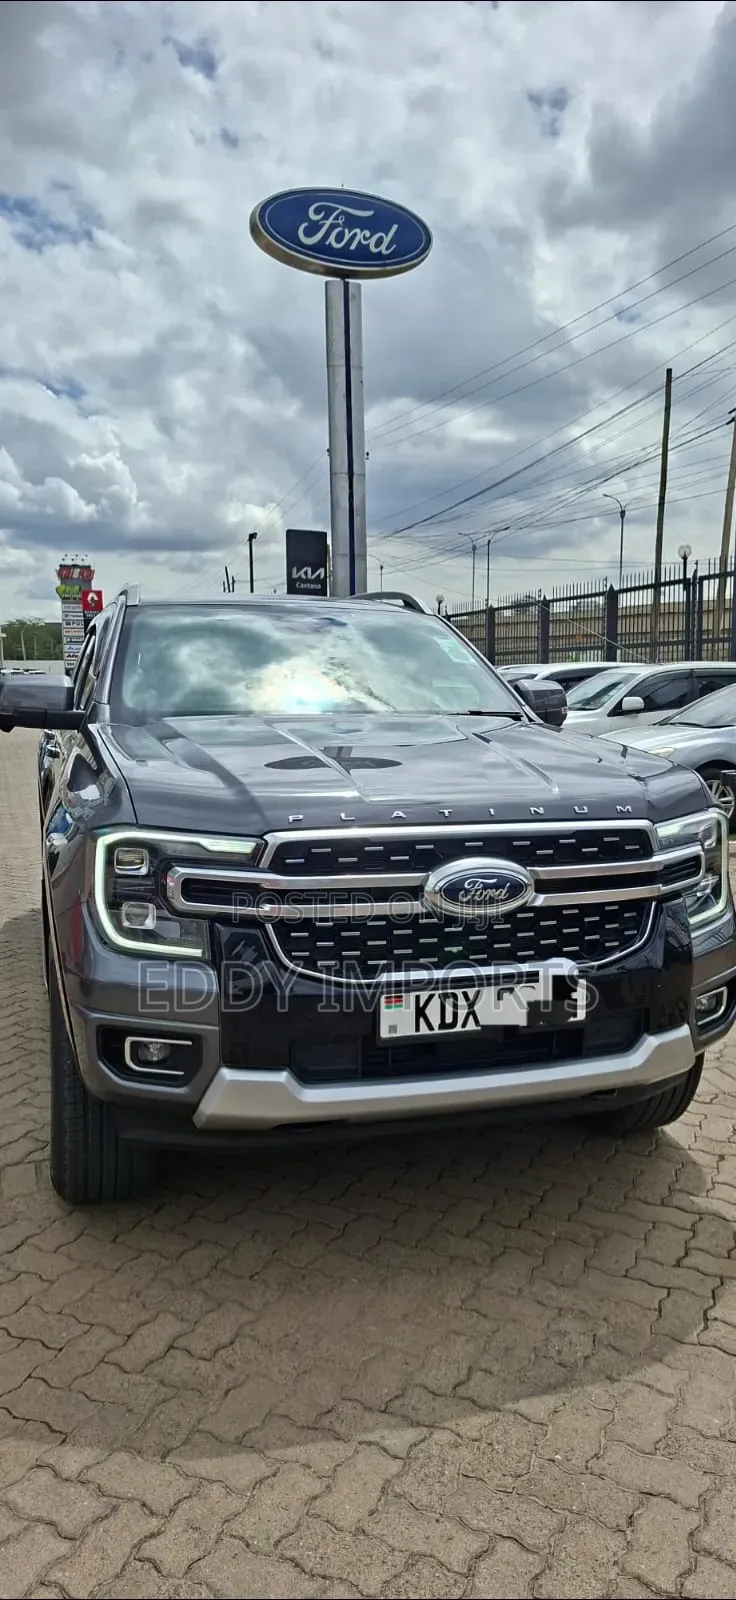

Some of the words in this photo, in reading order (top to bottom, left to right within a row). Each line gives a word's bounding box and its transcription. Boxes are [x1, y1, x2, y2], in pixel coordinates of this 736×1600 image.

[298, 202, 399, 254] Ford
[292, 566, 325, 579] KIA
[287, 805, 633, 824] PLATINUM
[459, 877, 510, 902] Ford
[414, 989, 481, 1033] KDX
